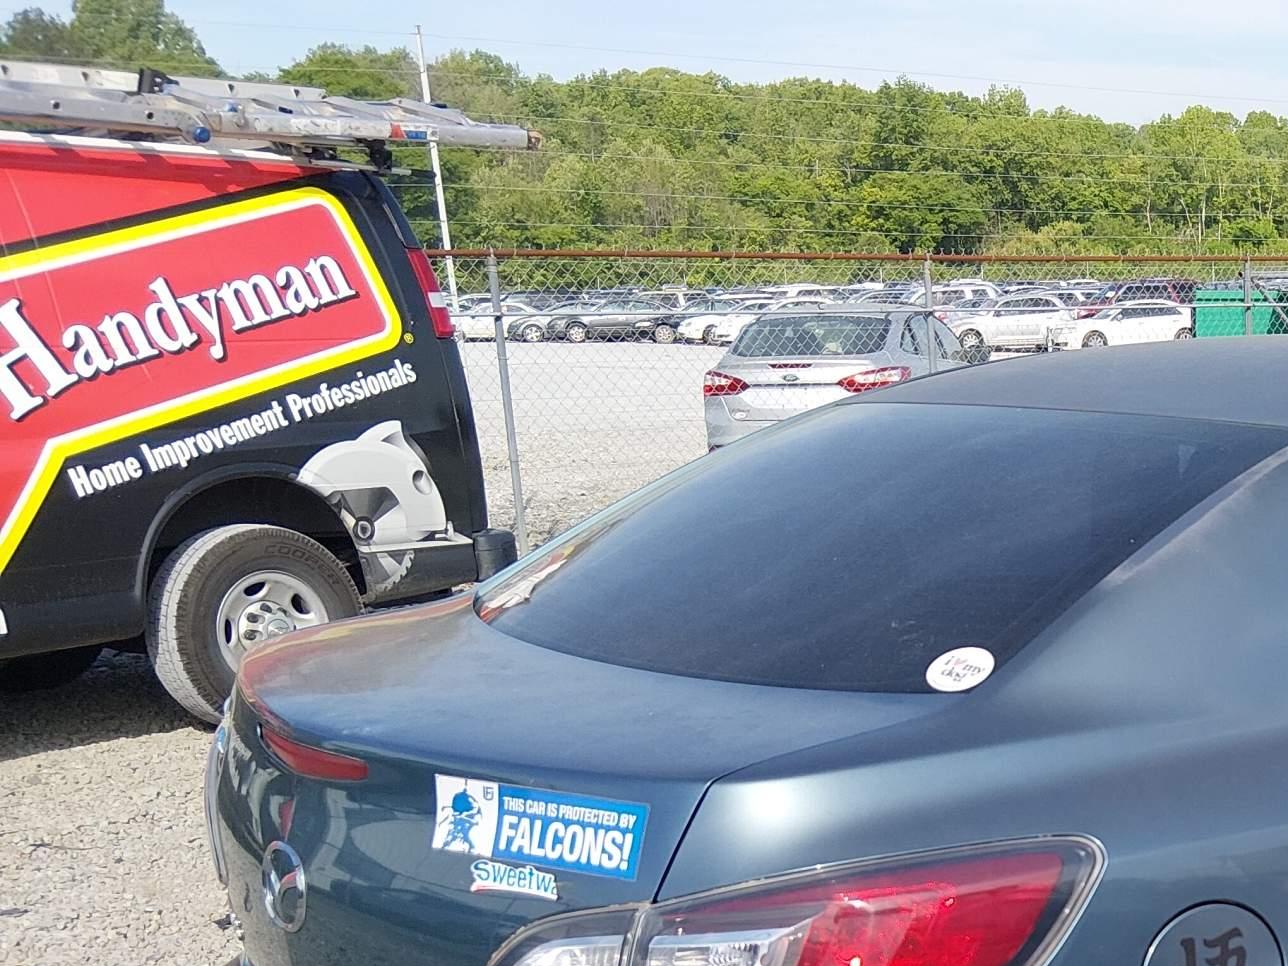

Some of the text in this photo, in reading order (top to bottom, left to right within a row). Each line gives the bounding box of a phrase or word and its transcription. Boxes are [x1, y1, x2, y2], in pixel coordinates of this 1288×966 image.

[0, 253, 359, 421] Handyman
[67, 359, 417, 498] Home Improvement Professionals
[499, 815, 634, 871] FALCONS!
[503, 796, 637, 829] THIS CAR IS PROTECTED BY
